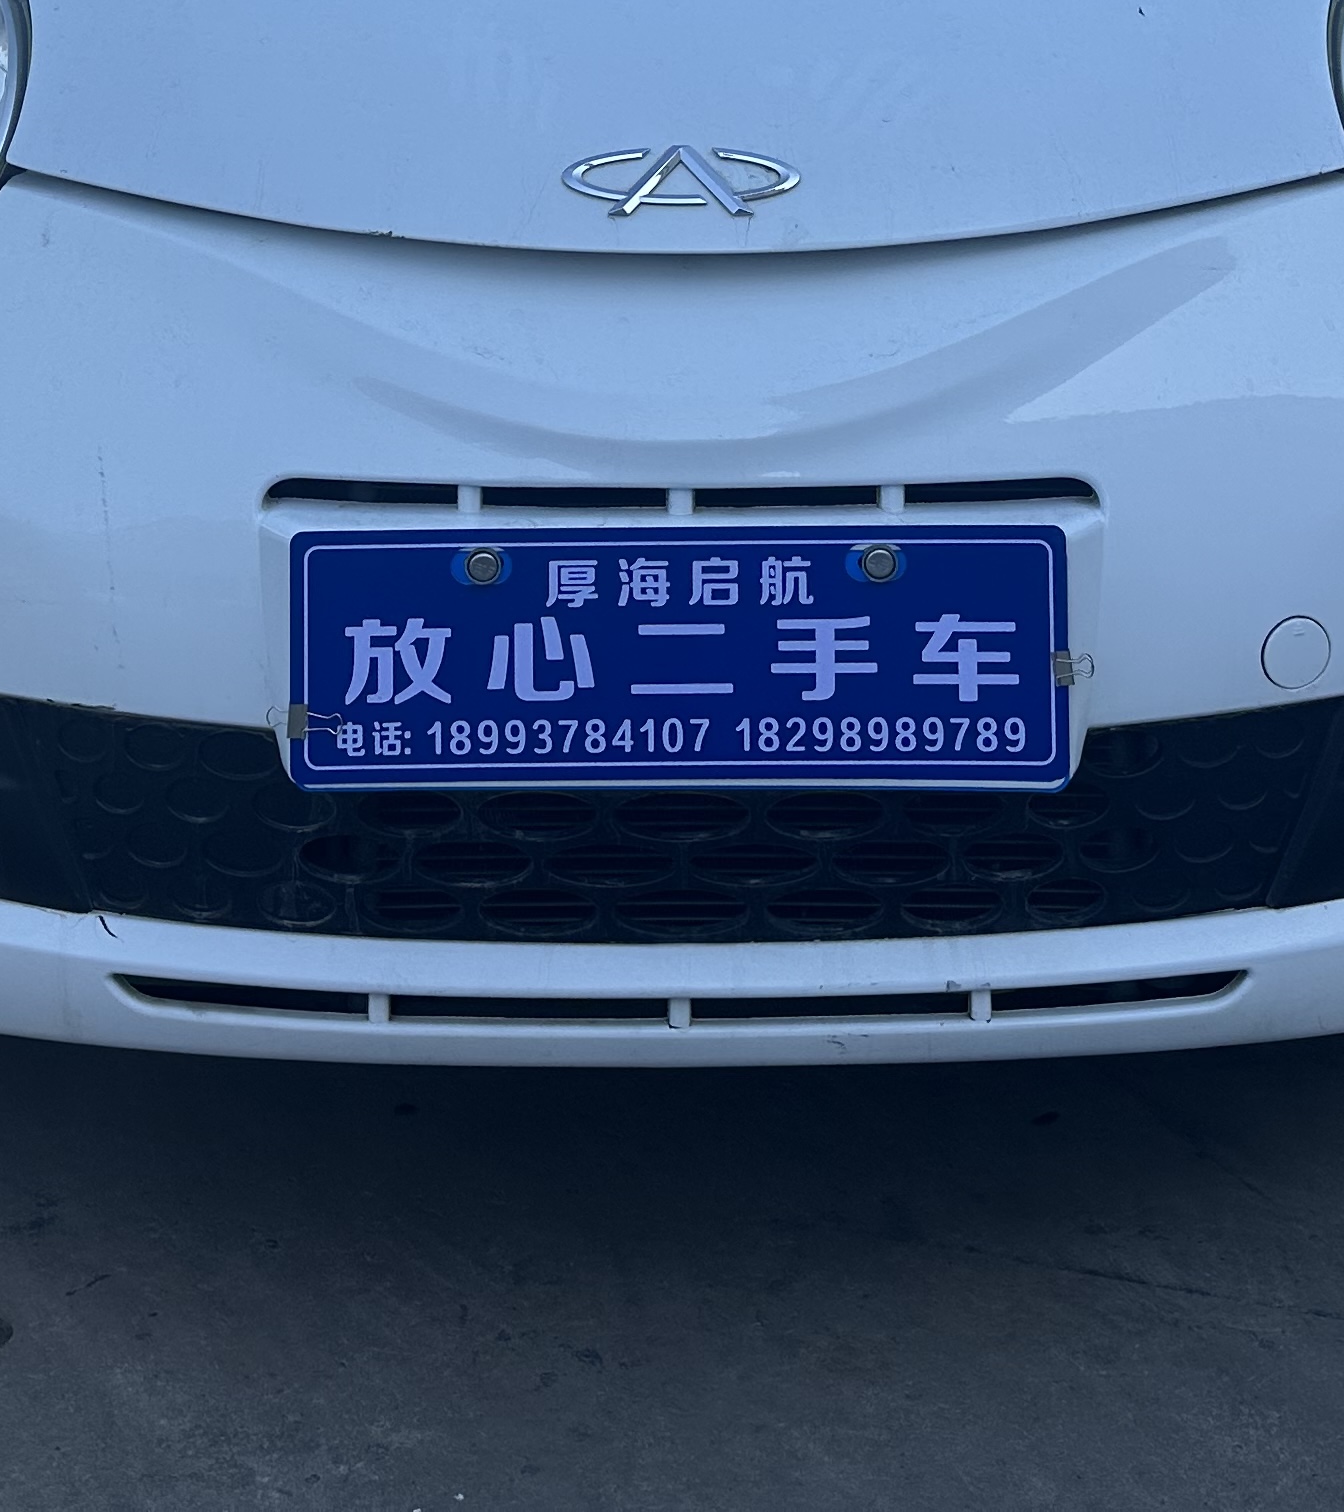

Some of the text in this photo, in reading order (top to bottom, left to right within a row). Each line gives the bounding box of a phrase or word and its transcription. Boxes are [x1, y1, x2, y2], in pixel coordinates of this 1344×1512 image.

[545, 555, 814, 608] 厚海启航
[344, 613, 1020, 706] 放心二手车
[426, 718, 710, 756] 18993784107
[735, 716, 1026, 753] 18298989789
